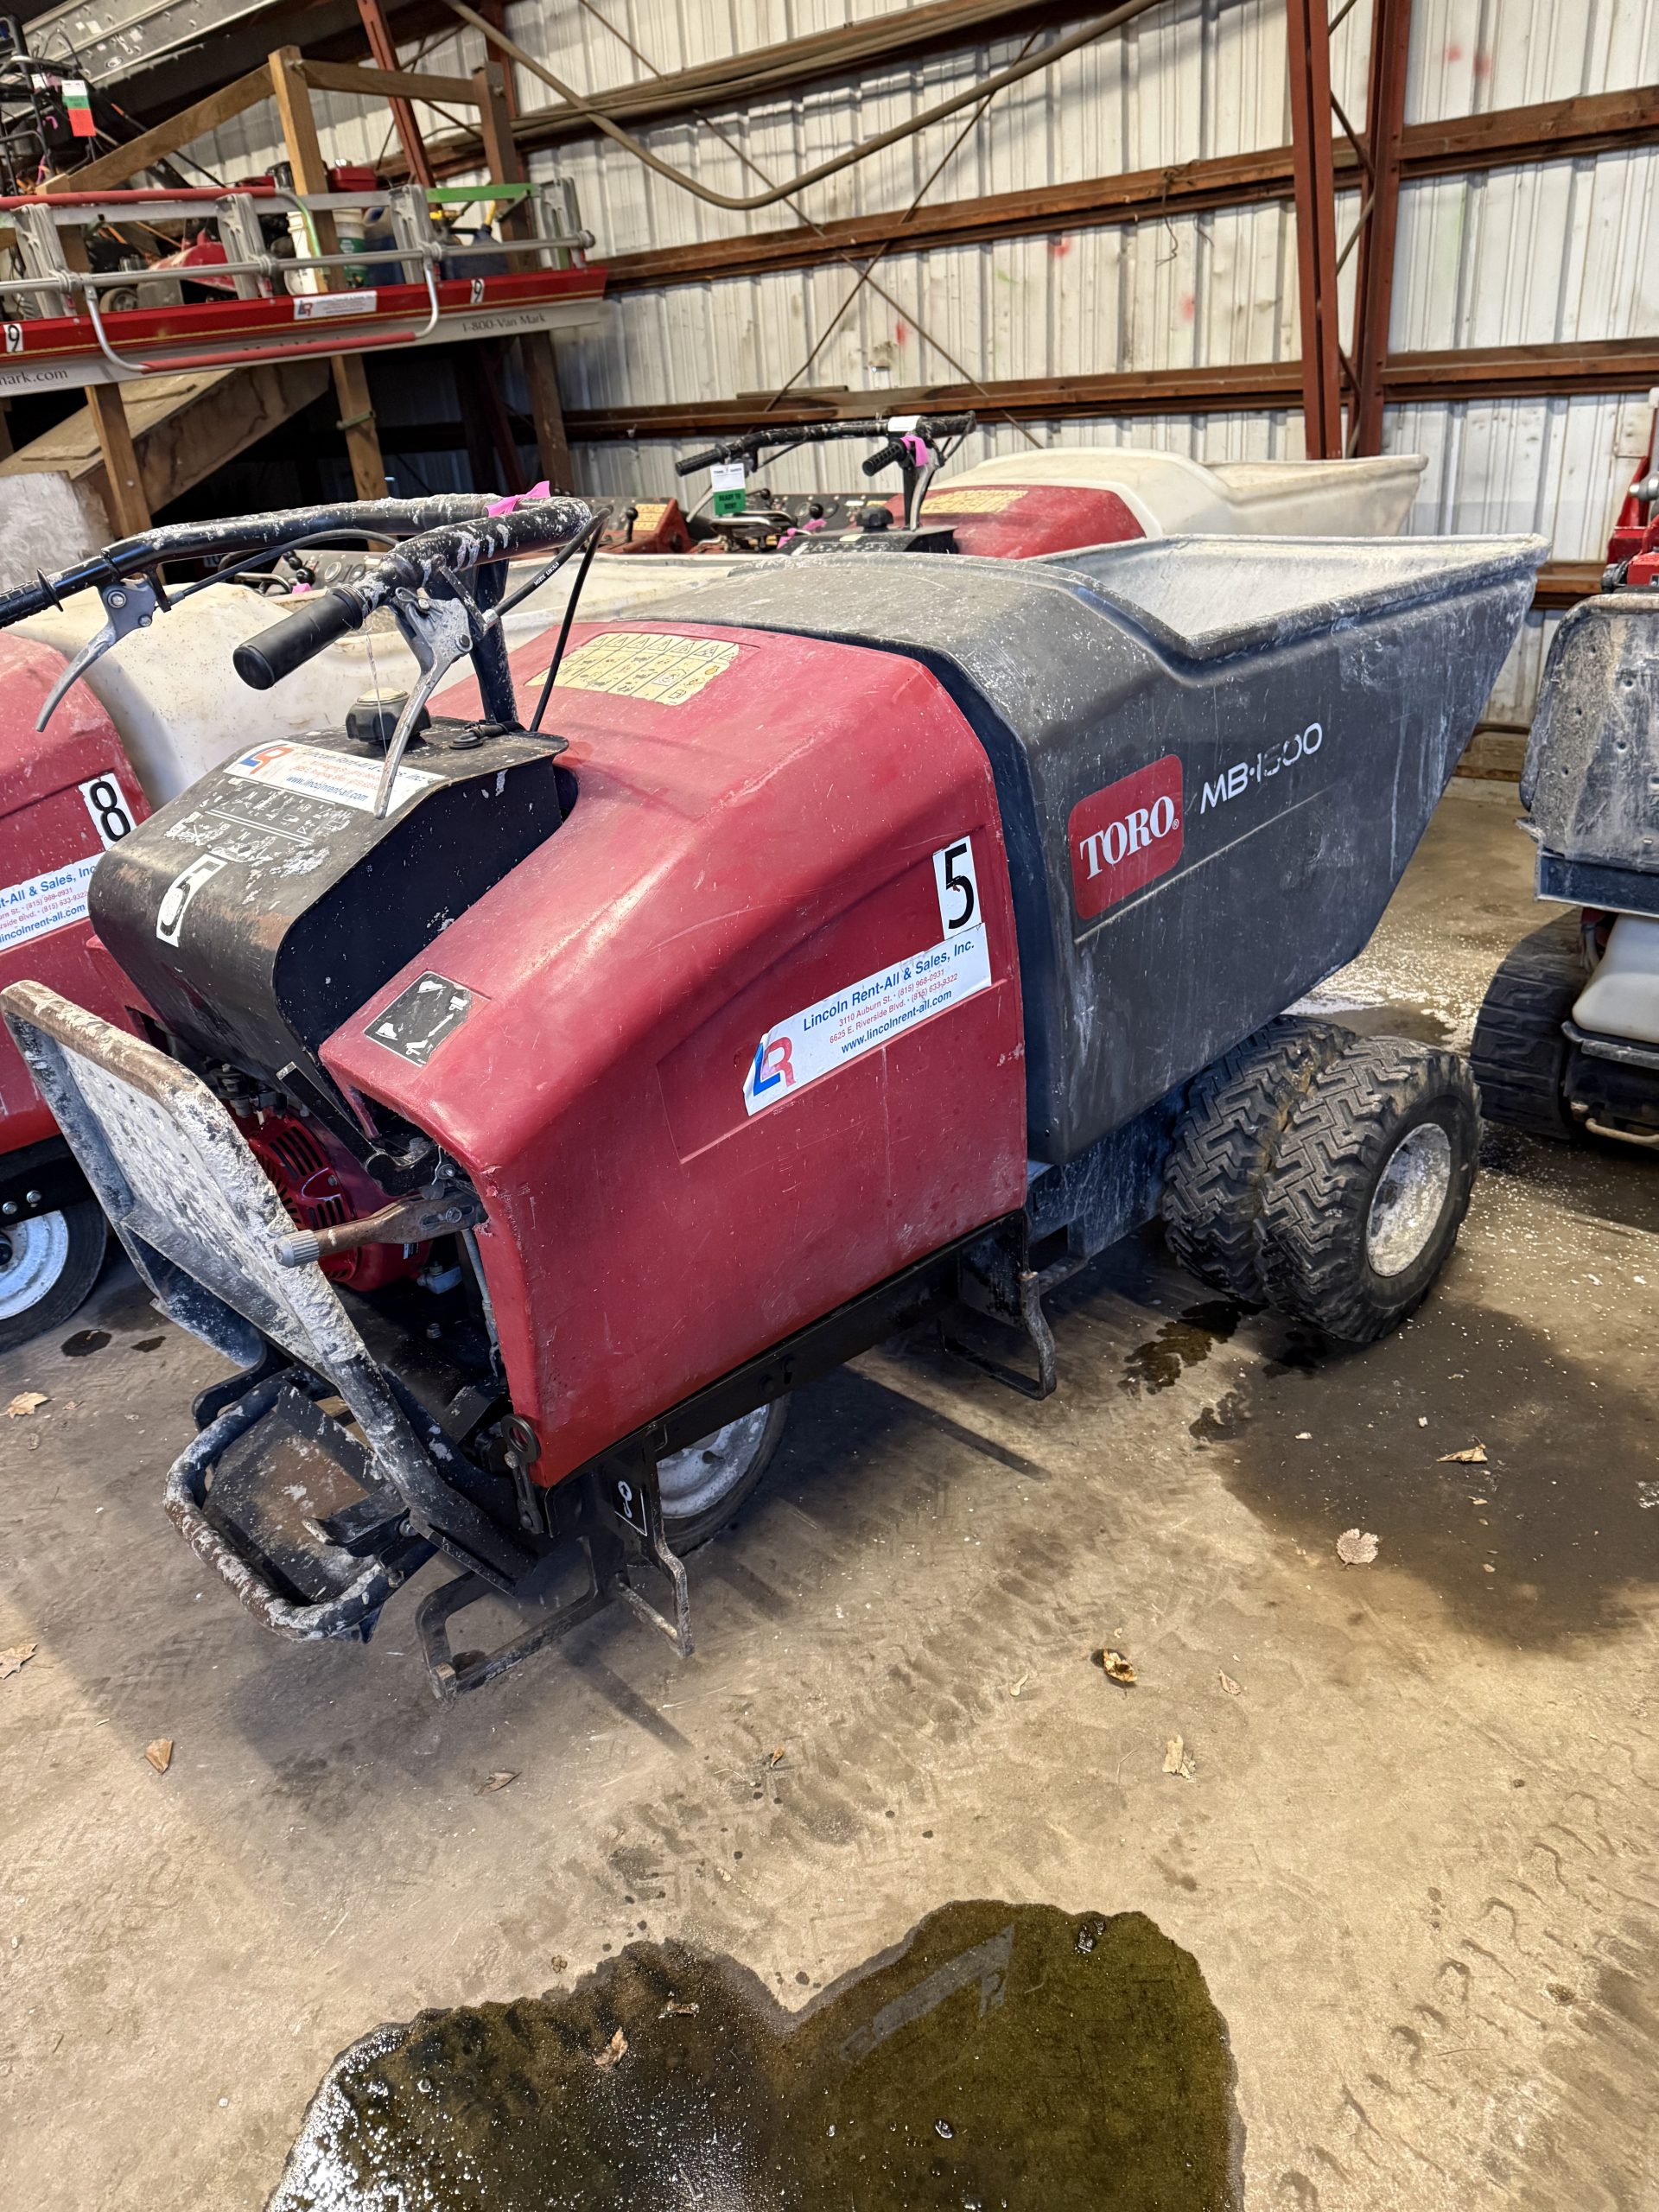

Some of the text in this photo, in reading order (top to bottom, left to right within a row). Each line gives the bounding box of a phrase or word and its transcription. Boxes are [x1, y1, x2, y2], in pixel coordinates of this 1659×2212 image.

[474, 279, 483, 303] 9
[519, 312, 546, 325] Mark
[8, 324, 20, 352] 9
[90, 780, 131, 842] 8
[0, 890, 26, 908] t-All
[29, 886, 38, 897] &
[41, 874, 77, 892] Sales,
[159, 860, 221, 937] 5
[944, 842, 975, 930] 5
[804, 940, 975, 1032] Lincoln Rent-All & Sales, Inc.
[830, 1030, 846, 1044] 6625
[847, 1027, 855, 1035] E.
[855, 1008, 887, 1030] Riverside
[888, 1000, 906, 1014] Blvd.
[929, 973, 958, 990] 633-9322
[839, 969, 944, 1027] 3110 Auburn St. (815) 968-0931
[841, 990, 952, 1053] www.lincolnrent-all.com
